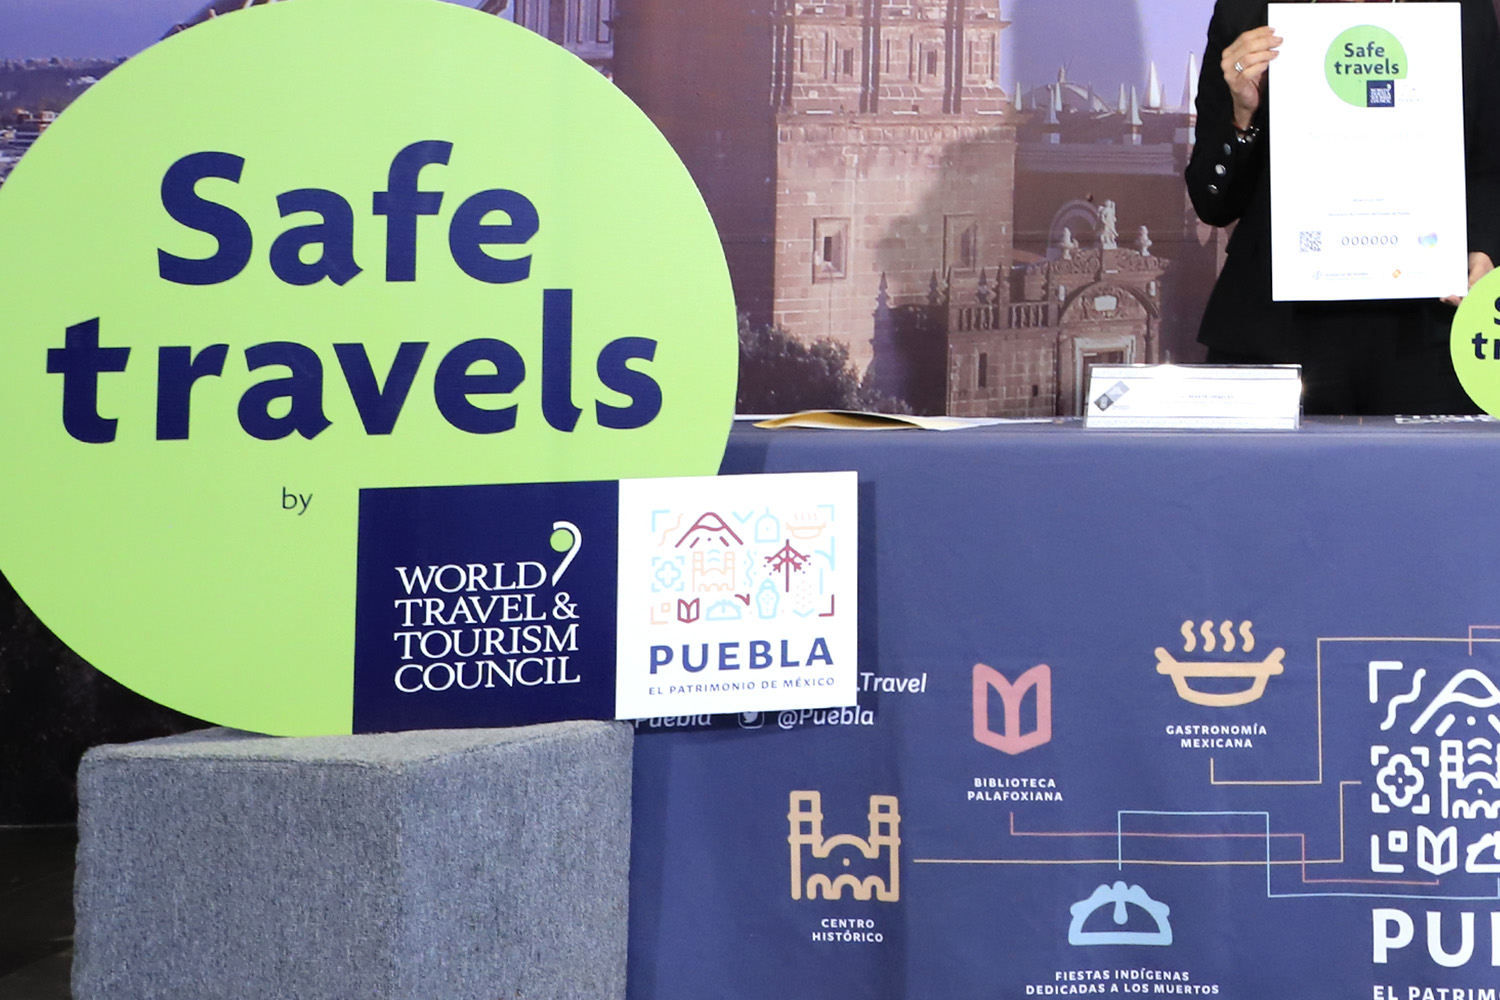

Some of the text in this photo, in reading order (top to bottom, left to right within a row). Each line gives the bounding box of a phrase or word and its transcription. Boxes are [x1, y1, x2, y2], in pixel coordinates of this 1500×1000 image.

[1345, 41, 1384, 57] Safe
[1334, 58, 1400, 75] travels
[157, 139, 541, 287] Safe
[46, 289, 662, 444] travels
[283, 487, 313, 515] by
[395, 561, 546, 595] WORLD
[395, 591, 580, 628] TRAVEL &
[394, 624, 580, 661] TOURISM
[650, 637, 833, 674] PUEBLA
[394, 656, 581, 693] COUNCIL
[648, 676, 835, 696] EL PATRIMONIO DE MÉXICO
[777, 705, 875, 729] @Puebla
[1165, 722, 1267, 735] GASTRONOMÍA
[1180, 738, 1253, 748] MEXICANA
[973, 777, 1056, 789] BIBLIOTECA
[967, 790, 1063, 802] PALAFOXIANA
[820, 918, 875, 929] CENTRO
[812, 929, 884, 943] HISTÓRICO
[1055, 967, 1190, 982] FIESTAS INDÍGENAS
[1025, 983, 1220, 995] DEDICADAS A LOS MUERTOS
